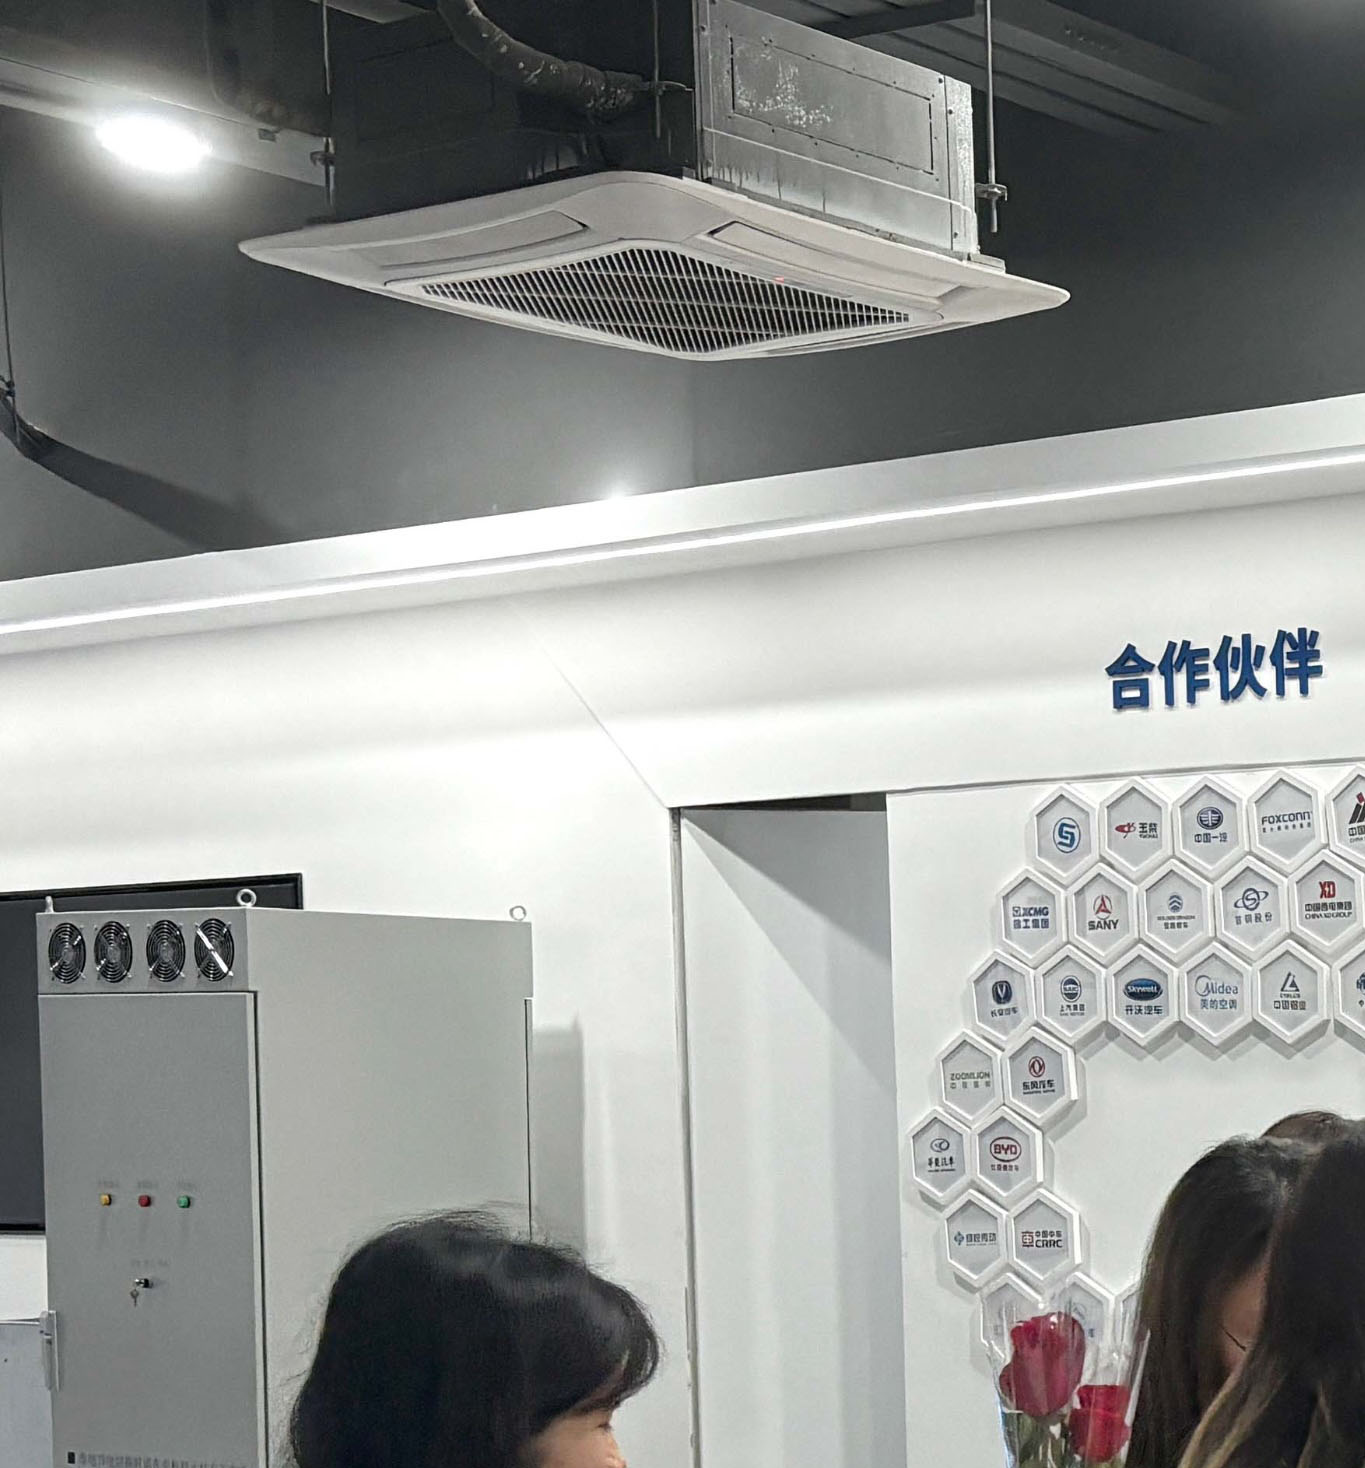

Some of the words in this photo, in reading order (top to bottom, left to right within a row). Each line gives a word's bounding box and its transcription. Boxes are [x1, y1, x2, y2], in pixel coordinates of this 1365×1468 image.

[1104, 627, 1324, 709] 合作伙伴
[1261, 811, 1313, 826] FOXCONN
[1087, 919, 1119, 931] SANY
[1195, 976, 1239, 997] Midea
[1124, 1004, 1163, 1016] 开沃汽车
[1199, 998, 1238, 1010] 美的空调
[993, 1143, 1018, 1156] BYD
[1034, 1238, 1063, 1249] CRRC
